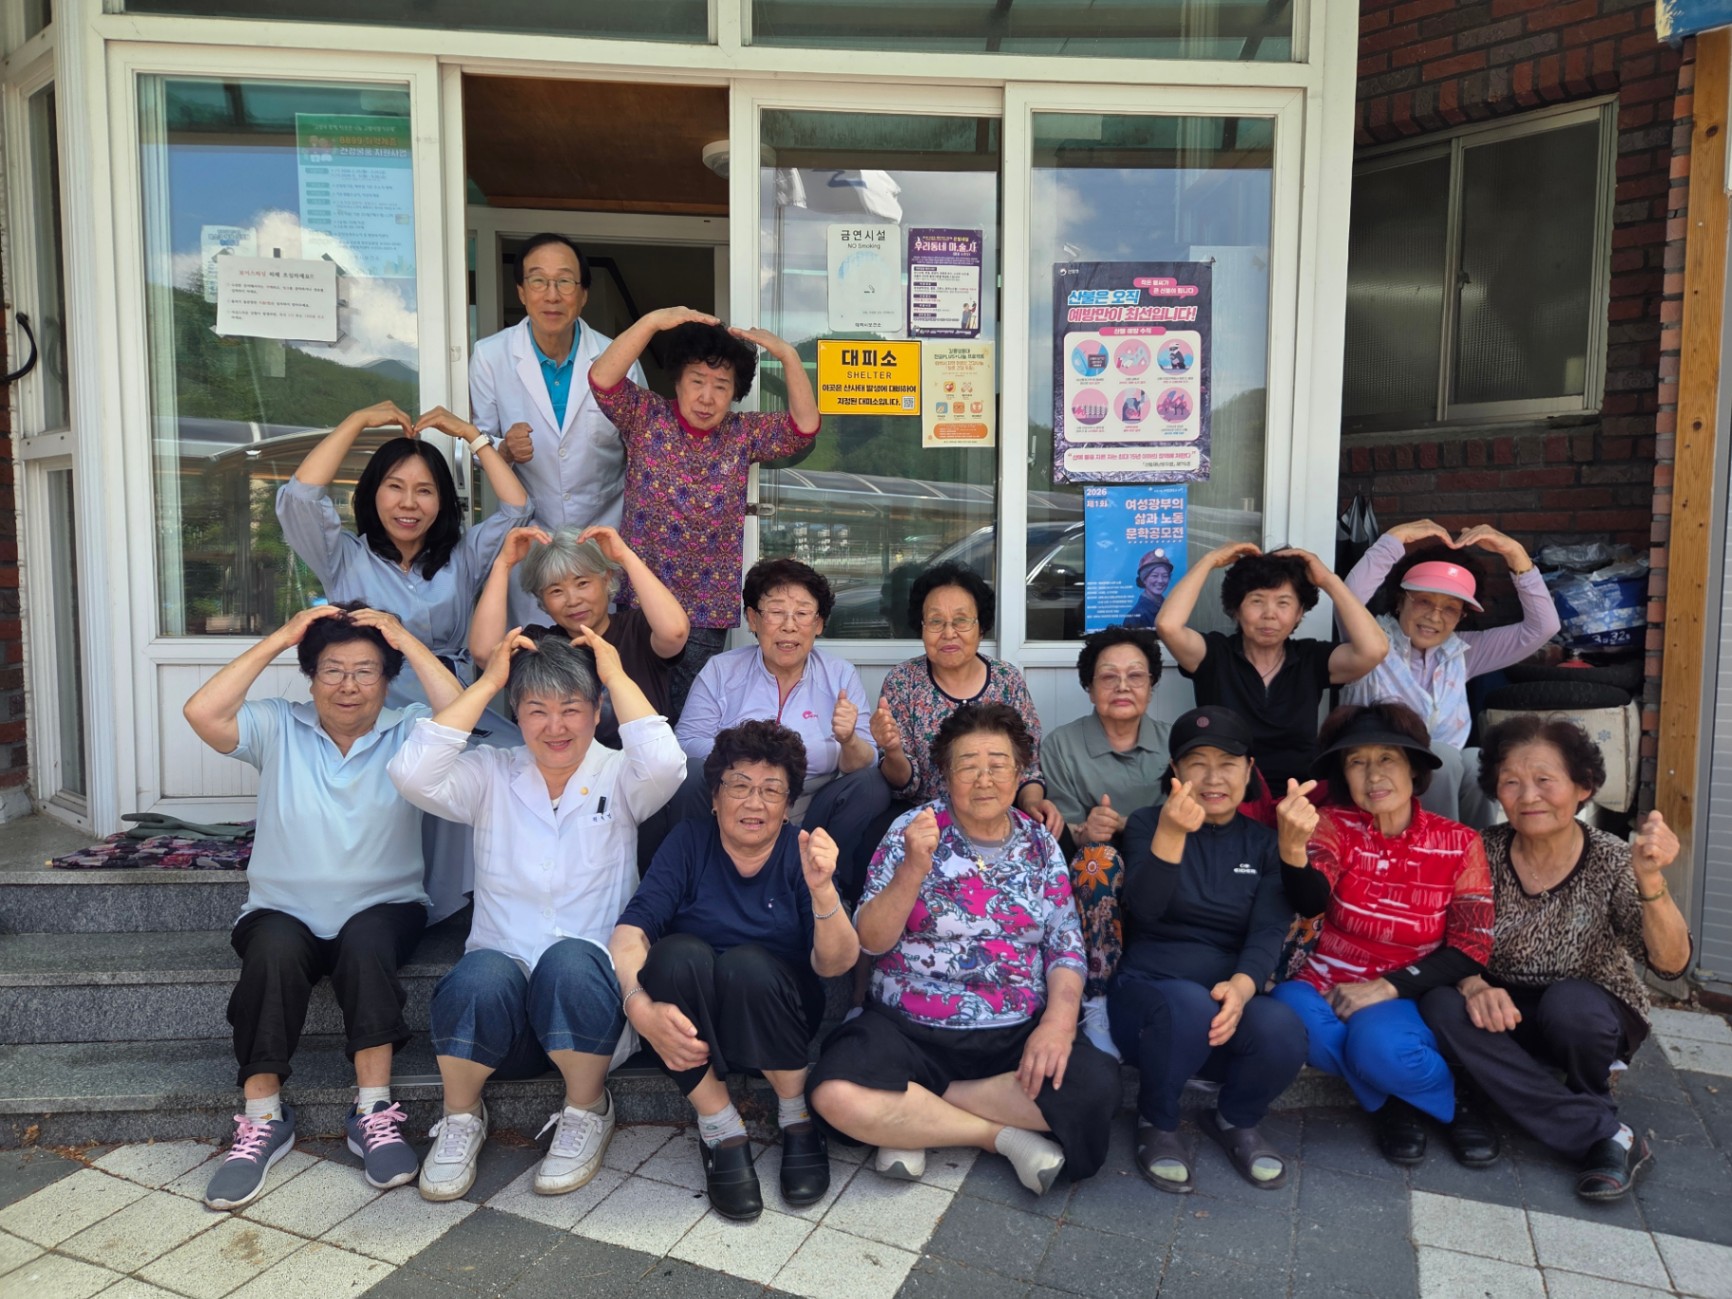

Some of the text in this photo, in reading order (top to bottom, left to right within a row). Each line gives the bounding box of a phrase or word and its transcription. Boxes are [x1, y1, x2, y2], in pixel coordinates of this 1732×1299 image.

[841, 230, 886, 242] 금연시설
[914, 241, 947, 252] 우리동네
[1068, 289, 1141, 305] 산불은 오직
[1068, 306, 1198, 322] 예방만이 최선입니다!
[842, 349, 897, 367] 대피소
[847, 371, 892, 379] SHELTER
[822, 384, 916, 393] 이곳은 산사태 발생에 대비하여
[837, 398, 901, 406] 지정된 대피소입니다.
[1086, 488, 1107, 496] 2026
[1125, 498, 1184, 510] 여성광부의
[1134, 512, 1184, 525] 삶과 노동
[1126, 527, 1184, 539] 문학공모전
